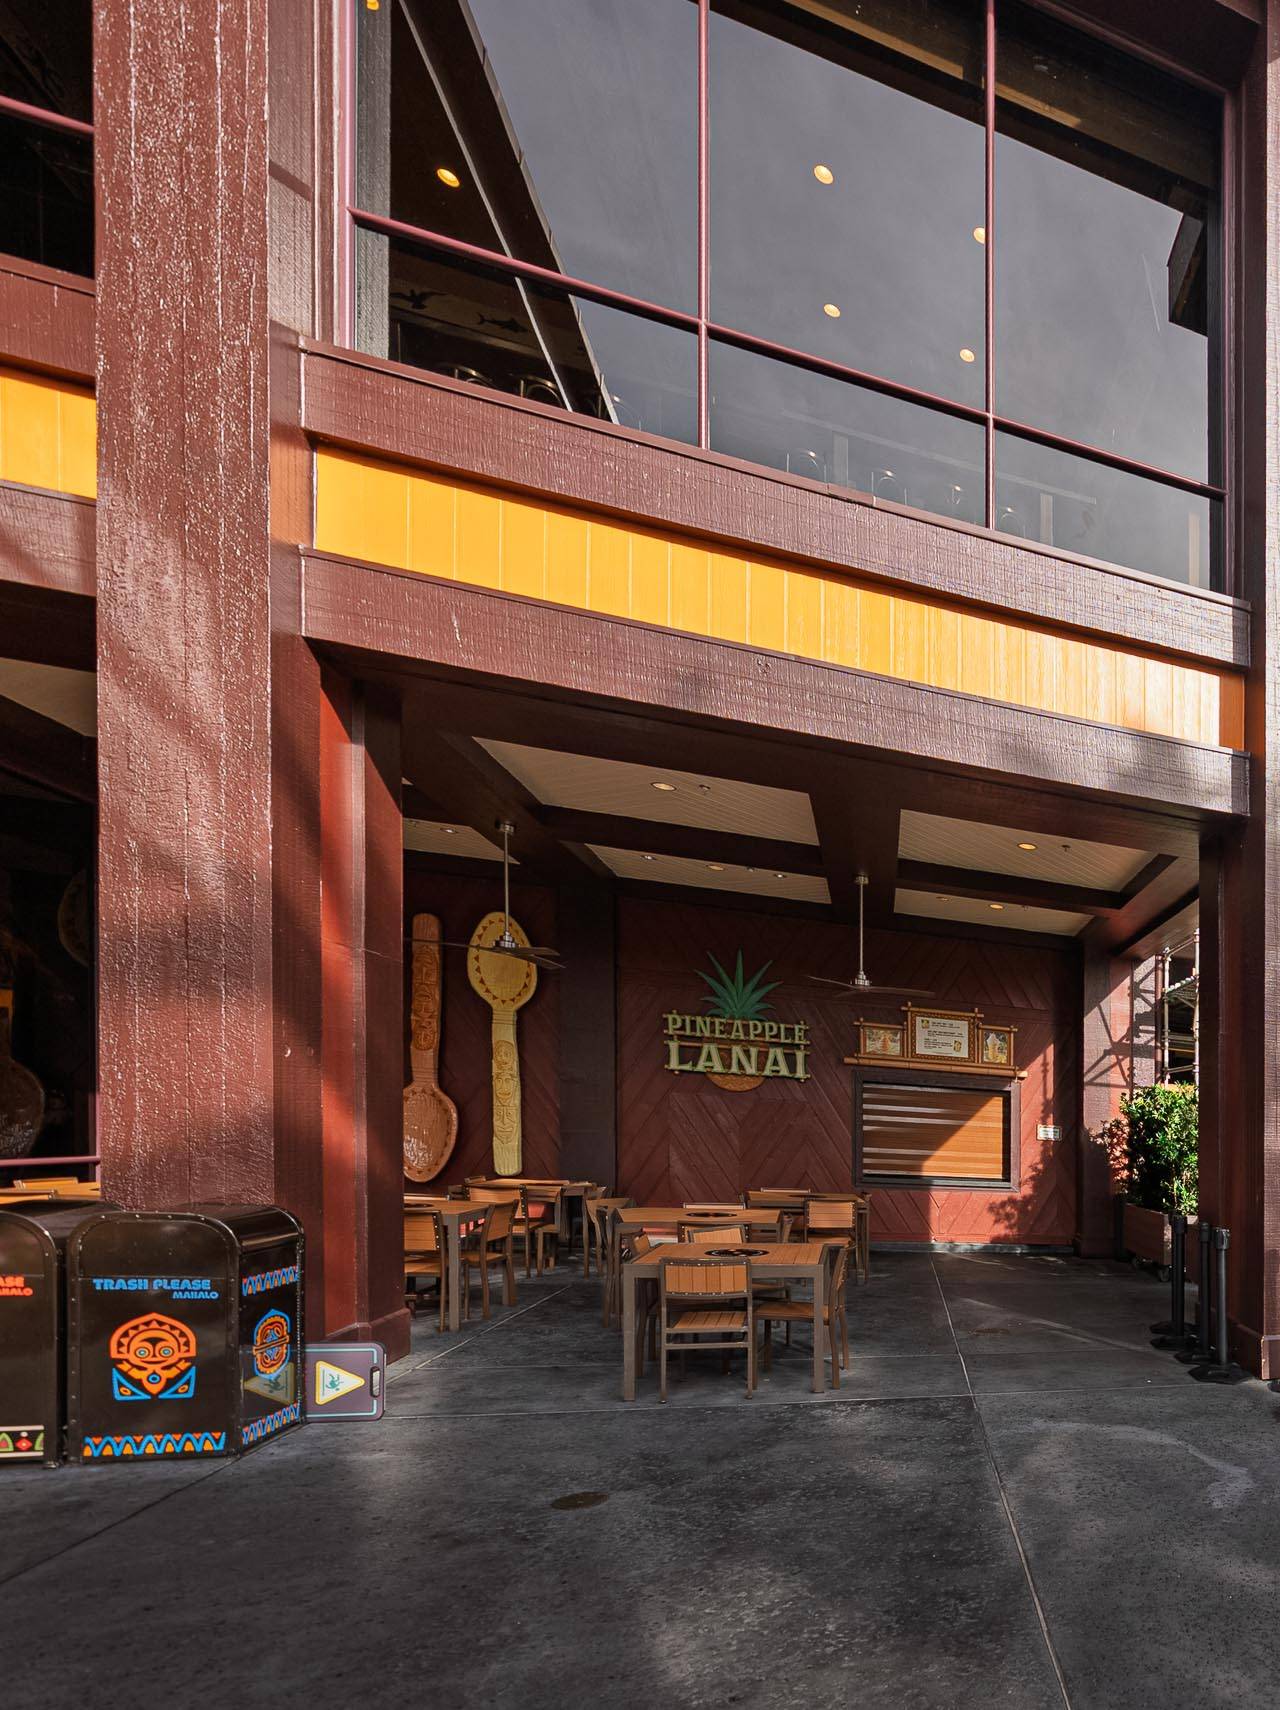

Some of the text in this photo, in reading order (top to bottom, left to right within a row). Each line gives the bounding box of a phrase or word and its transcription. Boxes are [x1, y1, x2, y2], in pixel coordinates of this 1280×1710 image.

[666, 1013, 806, 1044] PINEAPPLE
[667, 1040, 807, 1079] LANAI
[93, 1279, 211, 1290] TRASH PLEASE
[172, 1291, 219, 1300] MAHALO
